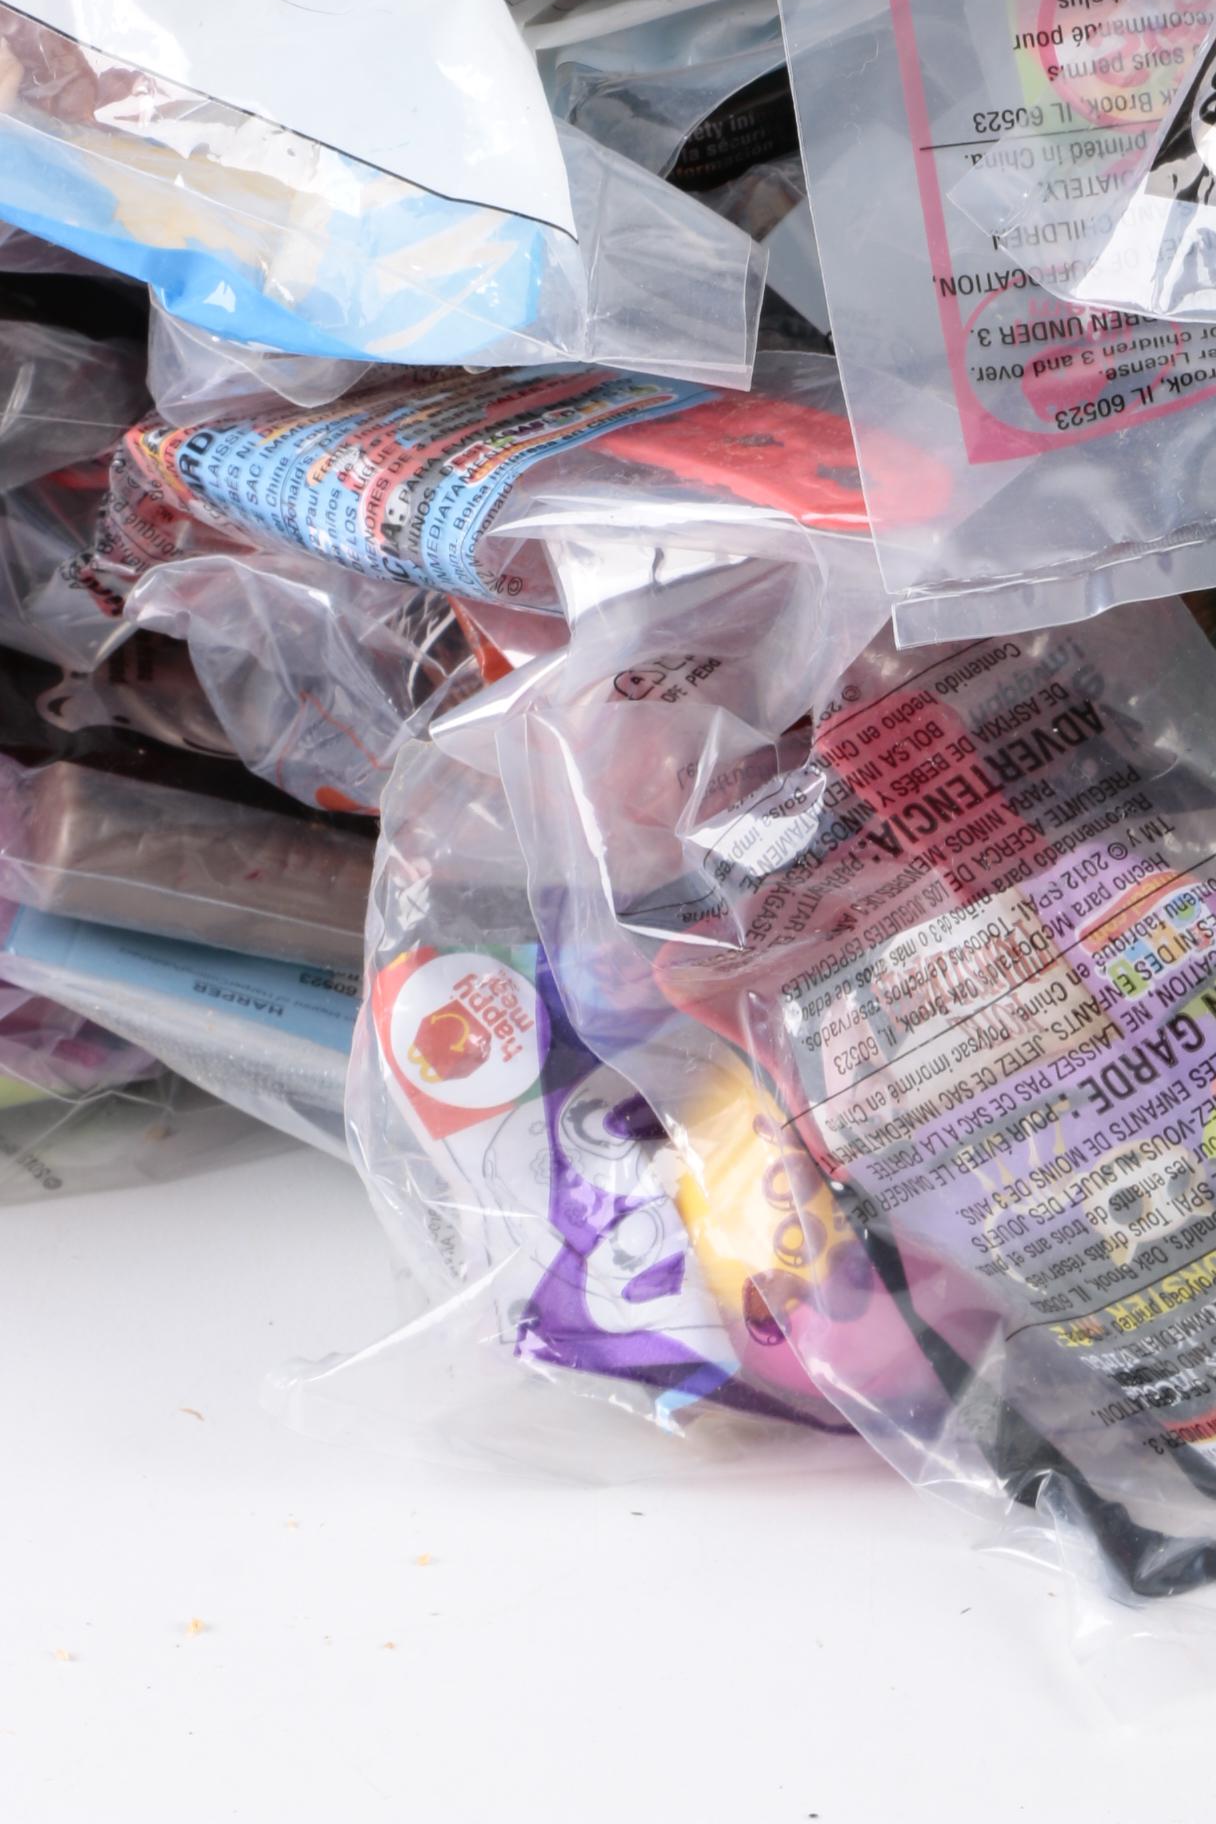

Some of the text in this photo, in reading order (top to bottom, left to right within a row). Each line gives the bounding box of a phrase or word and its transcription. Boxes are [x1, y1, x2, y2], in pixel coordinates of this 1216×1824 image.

[1011, 25, 1063, 51] pour
[969, 314, 1084, 349] UNDER 3.
[970, 330, 1193, 382] children 3 and over.
[1098, 350, 1192, 386] License.
[1056, 390, 1128, 430] 60523
[1129, 383, 1157, 409] IL
[856, 695, 1108, 873] ADVERTENCIA:
[193, 982, 283, 1016] HARPER
[452, 974, 525, 1062] happy
[1121, 999, 1154, 1030] NE
[1047, 1020, 1126, 1081] LAISSEZ
[1076, 1007, 1207, 1112] GARDE
[1013, 1068, 1052, 1103] PAS
[1111, 1078, 1193, 1144] ENFANTS
[1082, 1129, 1113, 1158] DE
[1028, 1144, 1085, 1190] MOINS
[1163, 1154, 1195, 1183] les
[1108, 1168, 1169, 1216] enfants
